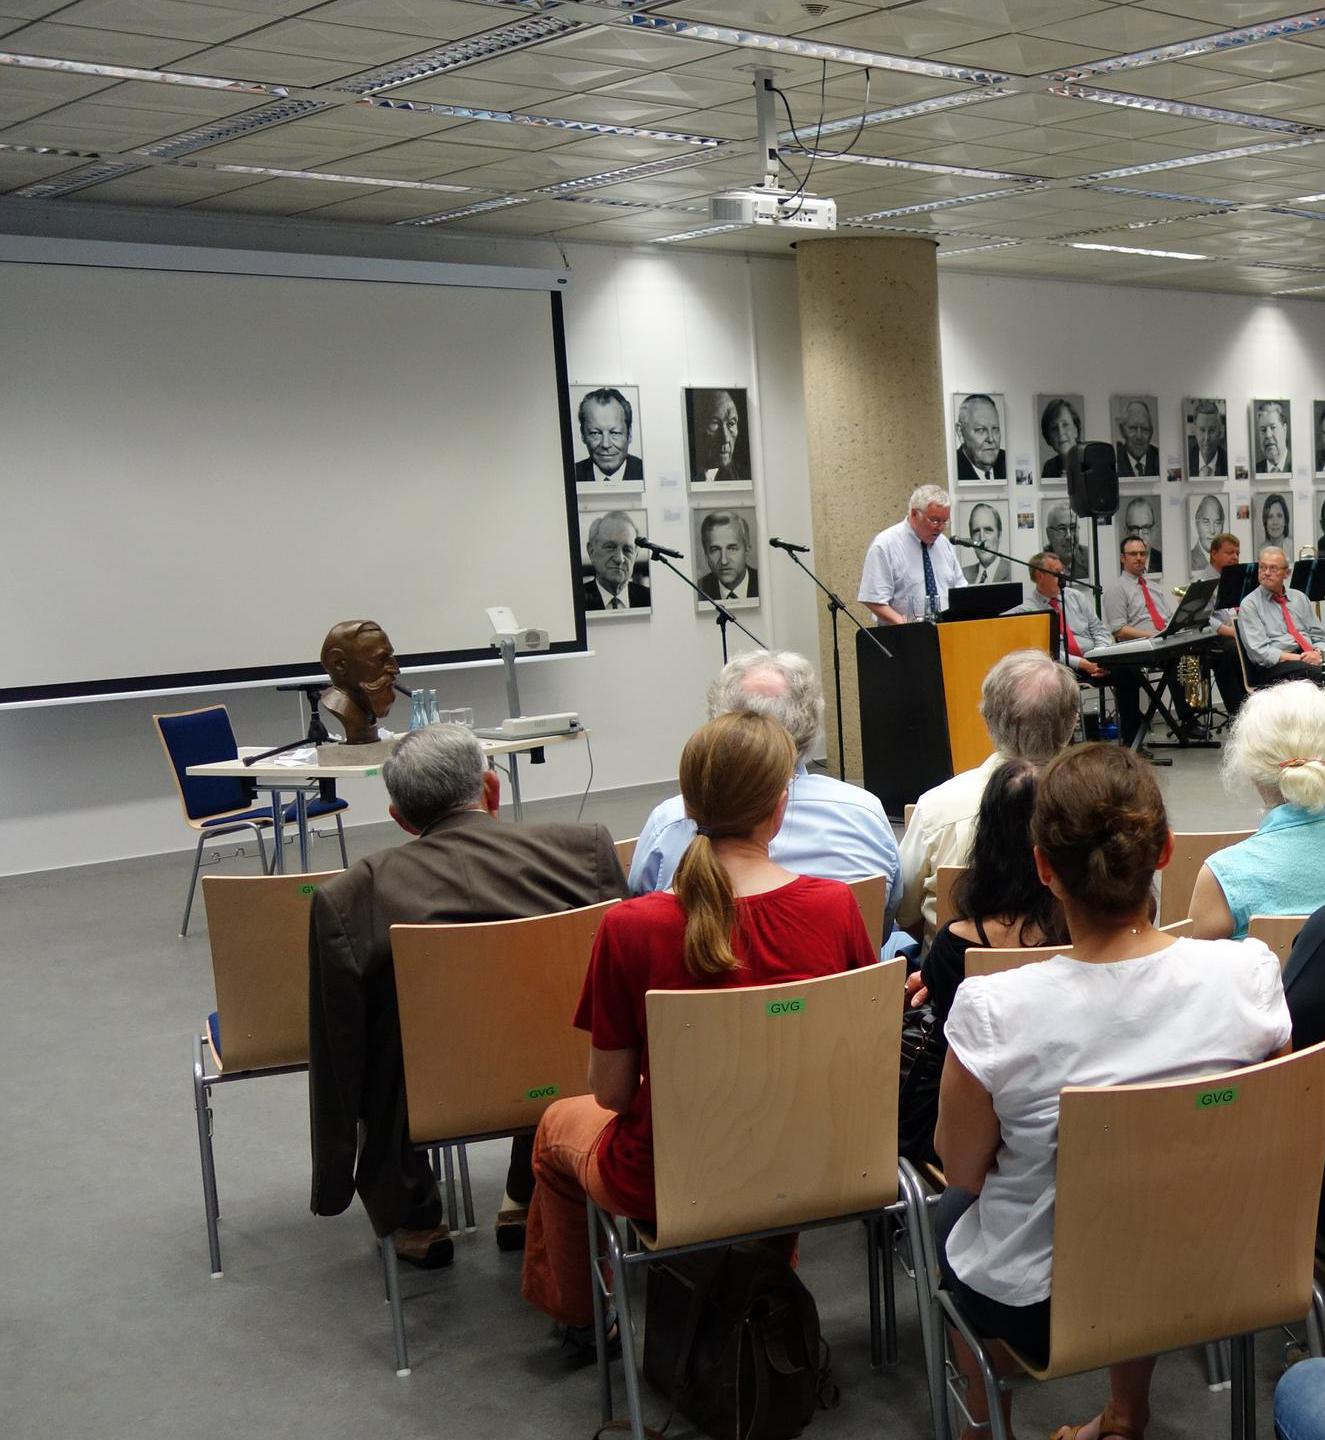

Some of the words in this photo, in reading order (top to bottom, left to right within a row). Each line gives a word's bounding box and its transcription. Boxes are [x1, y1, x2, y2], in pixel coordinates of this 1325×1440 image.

[770, 1001, 800, 1014] GVG
[529, 1087, 555, 1098] GVG
[1201, 1090, 1233, 1106] GVG
